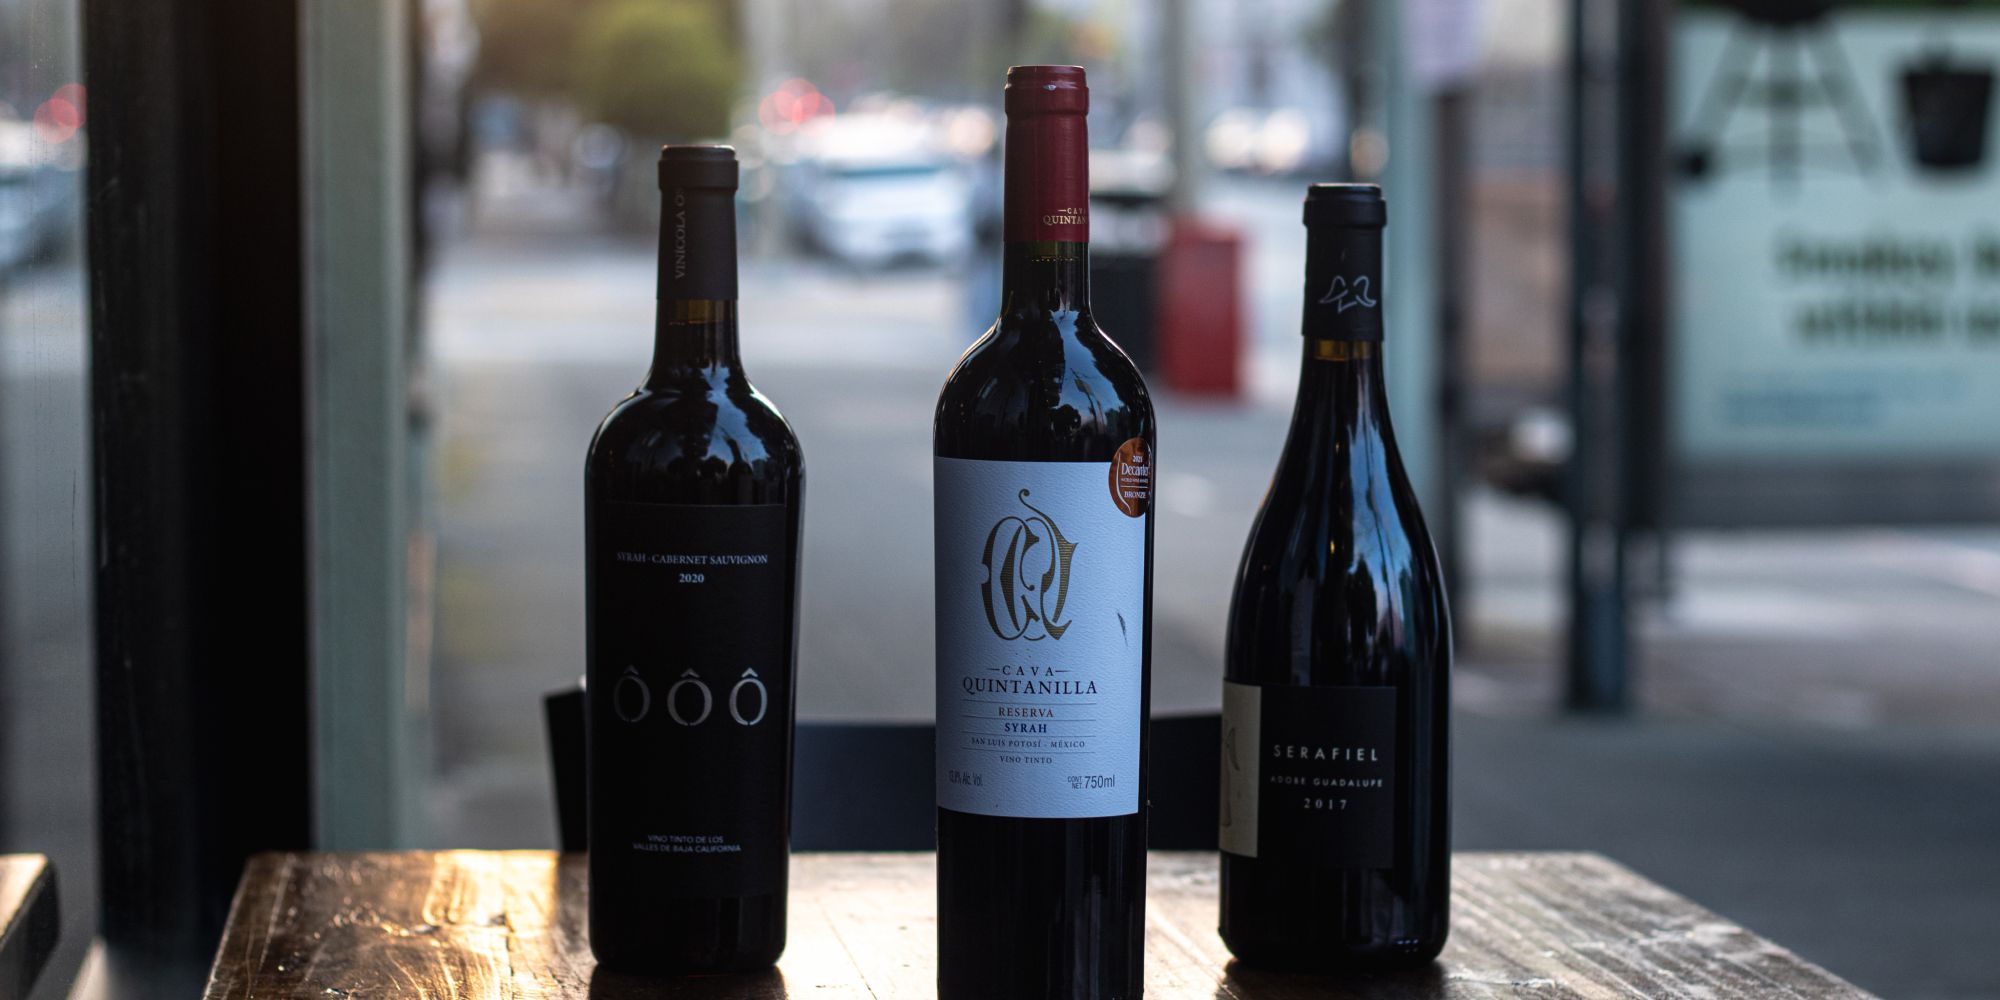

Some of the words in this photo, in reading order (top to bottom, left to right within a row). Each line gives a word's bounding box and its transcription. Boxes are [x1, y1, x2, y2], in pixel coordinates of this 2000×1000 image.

[1124, 490, 1146, 499] BRONZE
[616, 551, 646, 563] SYRAH
[651, 553, 708, 565] CABERNET
[709, 554, 768, 565] SAUVIGNON
[678, 573, 705, 583] 2020
[1002, 665, 1055, 676] CAVA
[962, 676, 1098, 695] QUINTANILLA
[998, 706, 1054, 718] RESERVA
[1004, 722, 1047, 733] SYRAH
[971, 737, 985, 745] SAN
[987, 738, 1006, 747] LUIS
[1008, 739, 1041, 748] POTOSÍ
[1050, 740, 1085, 748] MÉXICO
[1273, 744, 1378, 761] SERAFIEL
[1000, 755, 1021, 763] VINO
[1024, 756, 1053, 764] TINTO
[1084, 774, 1115, 789] 750ml
[1270, 775, 1306, 785] ADOBE
[1313, 777, 1383, 788] GUADALUPE
[1304, 798, 1347, 810] 2017
[647, 834, 668, 843] VINO
[669, 835, 694, 844] TINTO
[695, 835, 706, 844] DE
[708, 835, 724, 844] LOS
[632, 842, 658, 852] VALLES
[659, 844, 670, 852] DE
[673, 844, 694, 853] BAJA
[695, 844, 742, 853] CALIFORNIA
